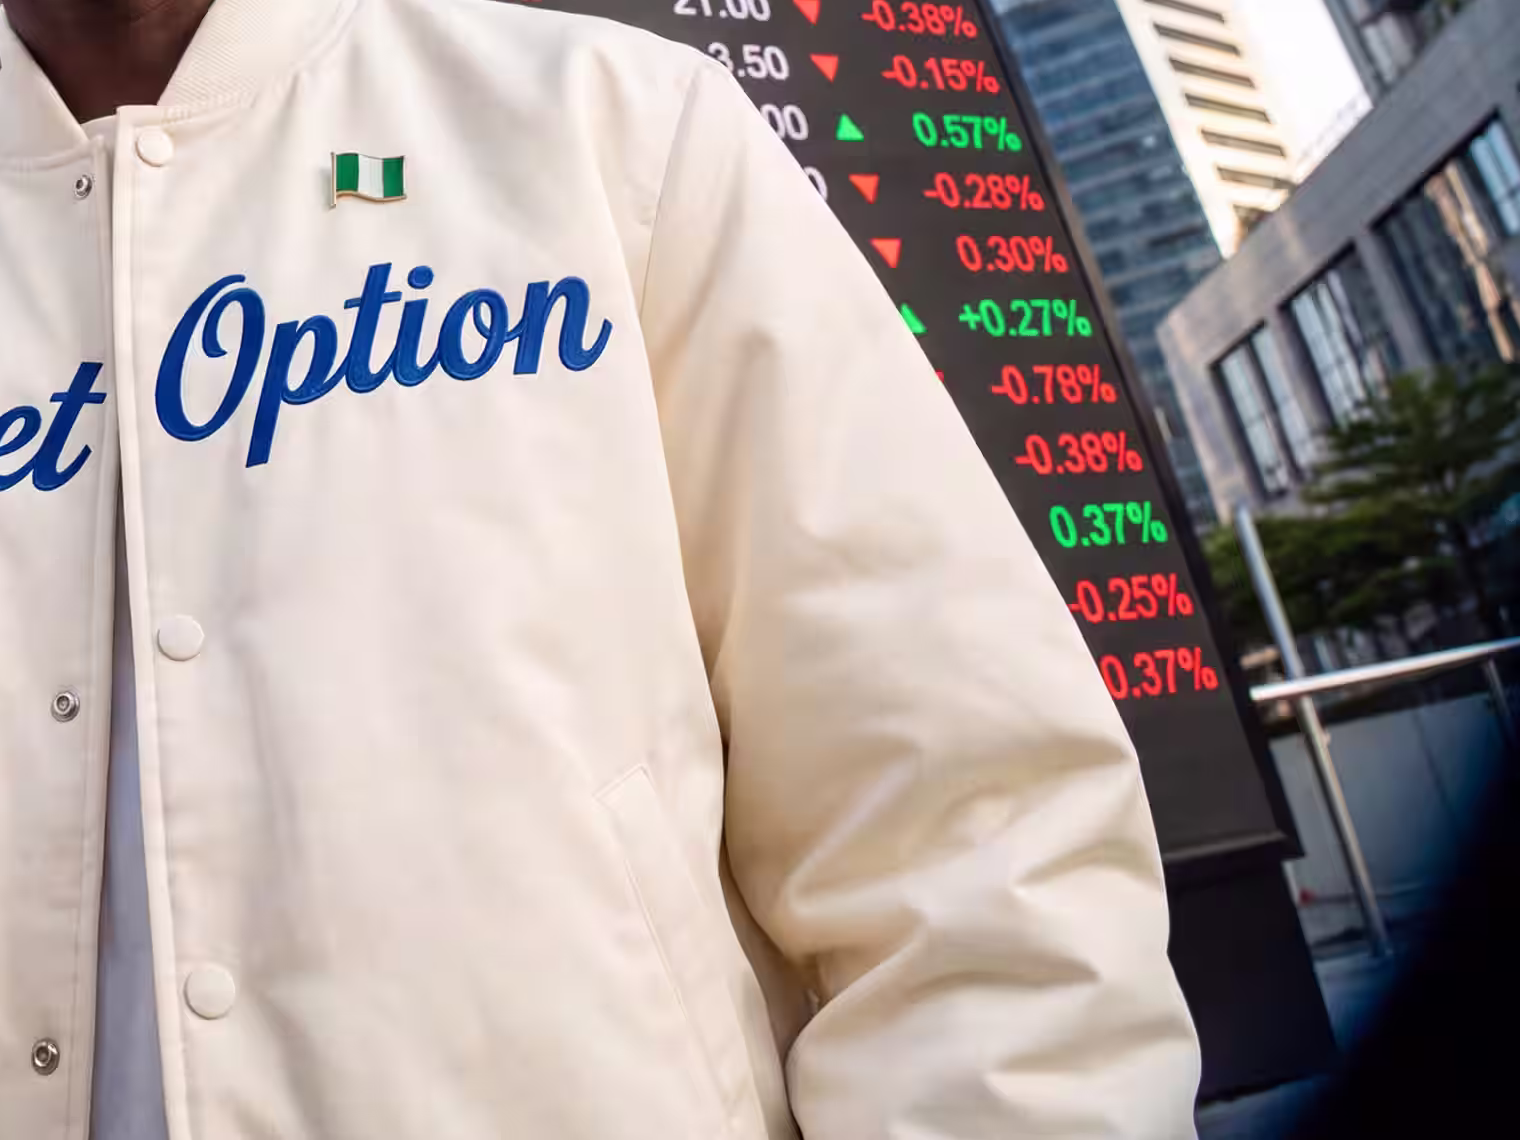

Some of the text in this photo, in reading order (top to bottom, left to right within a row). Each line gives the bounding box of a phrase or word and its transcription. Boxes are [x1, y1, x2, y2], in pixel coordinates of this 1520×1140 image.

[882, 56, 1000, 94] -0.15%
[913, 113, 1021, 150] 0.57%
[924, 172, 1044, 210] -0.28%
[956, 234, 1068, 272] 0.30%
[959, 299, 1092, 336] +0.27%
[155, 262, 613, 468] Option
[992, 364, 1116, 404] -0.78%
[1016, 432, 1143, 474] -0.38%
[1050, 502, 1167, 548] 0.37%
